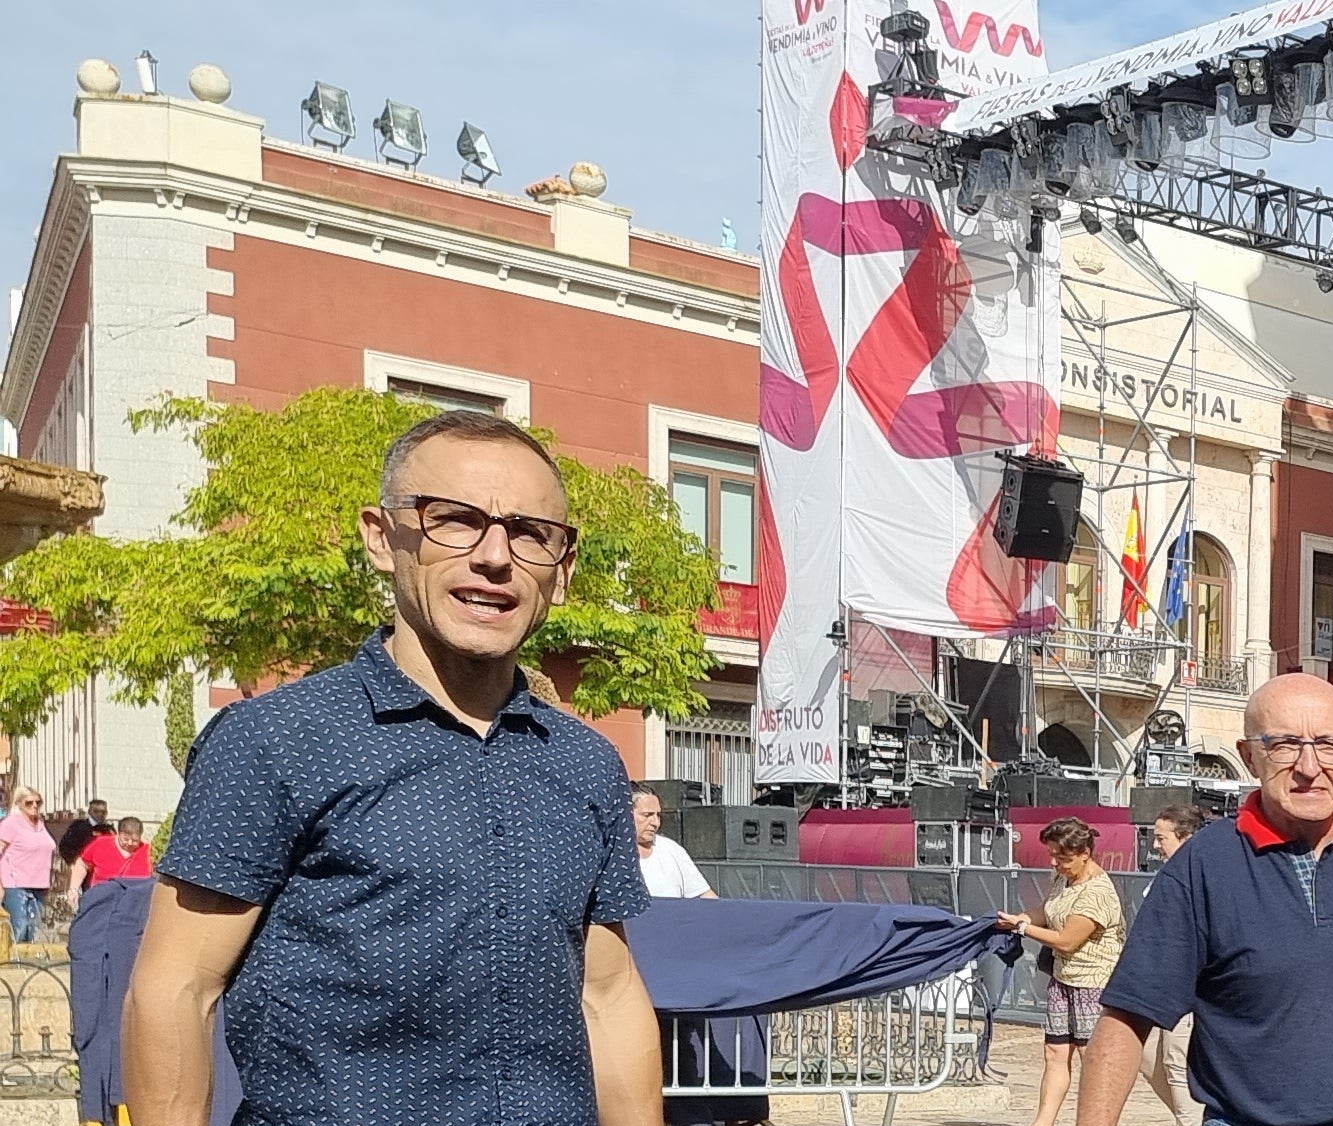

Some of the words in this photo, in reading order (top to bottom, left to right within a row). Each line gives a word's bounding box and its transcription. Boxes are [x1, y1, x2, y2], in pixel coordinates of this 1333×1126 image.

[816, 16, 838, 39] VINO
[1093, 45, 1198, 87] VENDIMIA
[1210, 13, 1273, 50] VINO
[759, 706, 824, 732] DISFRUTO
[759, 744, 773, 766] DE
[778, 743, 795, 766] LA
[800, 741, 833, 765] VIDA
